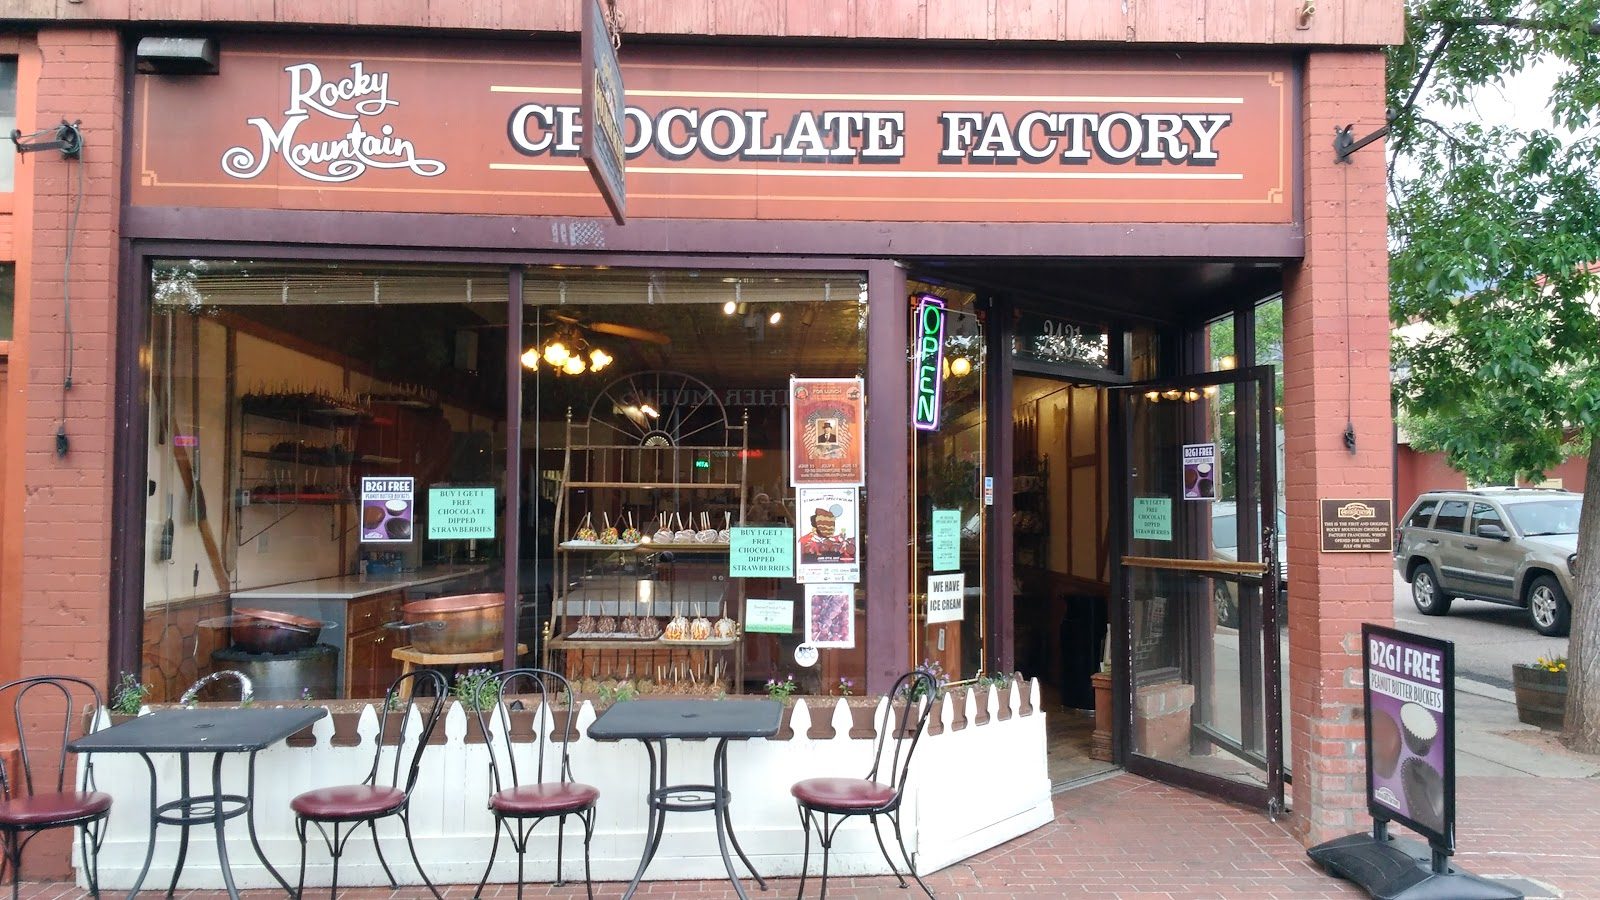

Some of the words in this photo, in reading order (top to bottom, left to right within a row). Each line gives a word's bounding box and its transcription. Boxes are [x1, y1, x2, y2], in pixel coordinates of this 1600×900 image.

[284, 61, 400, 120] Rocky
[221, 115, 447, 182] Mountain
[507, 102, 906, 164] CHOCOLATE
[938, 110, 1233, 166] FACTORY
[918, 305, 940, 422] OPEN
[1184, 448, 1199, 457] B2G1
[1199, 447, 1213, 456] FREE
[365, 481, 387, 492] B2G1
[388, 481, 410, 492] FREE
[930, 599, 940, 611] ICE
[942, 598, 961, 610] CREAM
[933, 581, 943, 592] WE
[945, 580, 960, 592] HAVE
[1370, 639, 1401, 672] B2G1
[1404, 648, 1440, 683] FREE
[1371, 672, 1392, 693] PEANUT
[1392, 680, 1413, 701] BUTTER
[1413, 686, 1442, 708] BUCKETS
